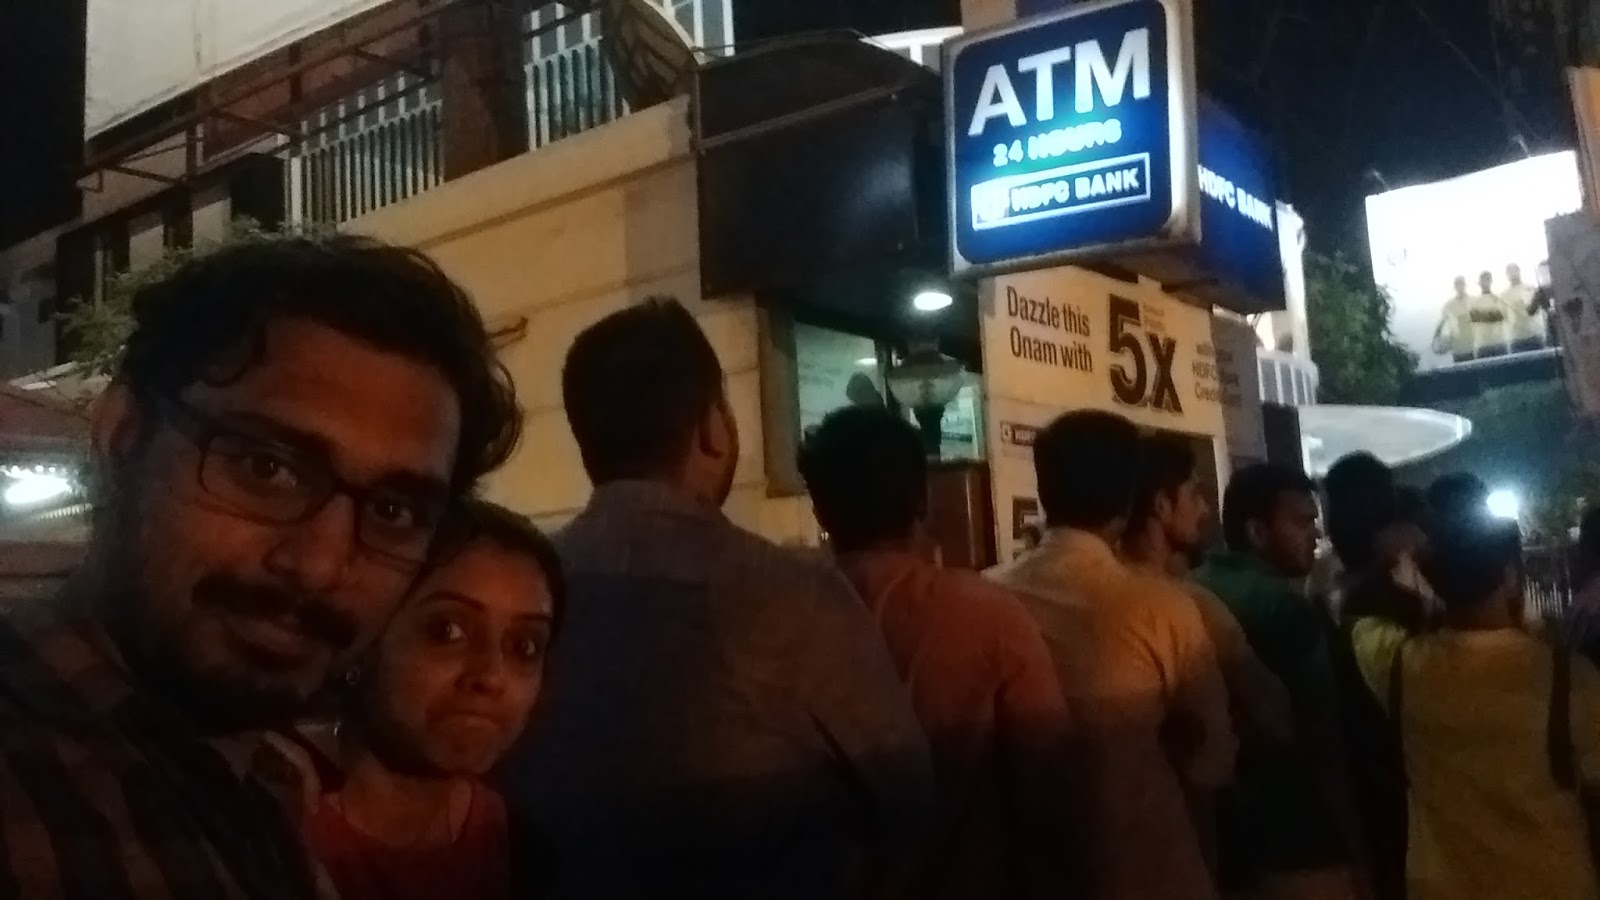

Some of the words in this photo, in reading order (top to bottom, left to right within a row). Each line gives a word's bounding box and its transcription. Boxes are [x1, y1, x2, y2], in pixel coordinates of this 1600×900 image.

[967, 27, 1150, 136] ATM
[992, 139, 1024, 168] 24
[1027, 118, 1123, 160] HOURS
[1011, 180, 1070, 212] HDFC
[1074, 167, 1140, 200] BANK
[1197, 164, 1236, 210] HDFC
[1236, 187, 1274, 231] BANK
[1006, 285, 1060, 330] Dazzle
[1063, 302, 1091, 337] this
[1010, 325, 1058, 366] Onam
[1060, 340, 1093, 373] with
